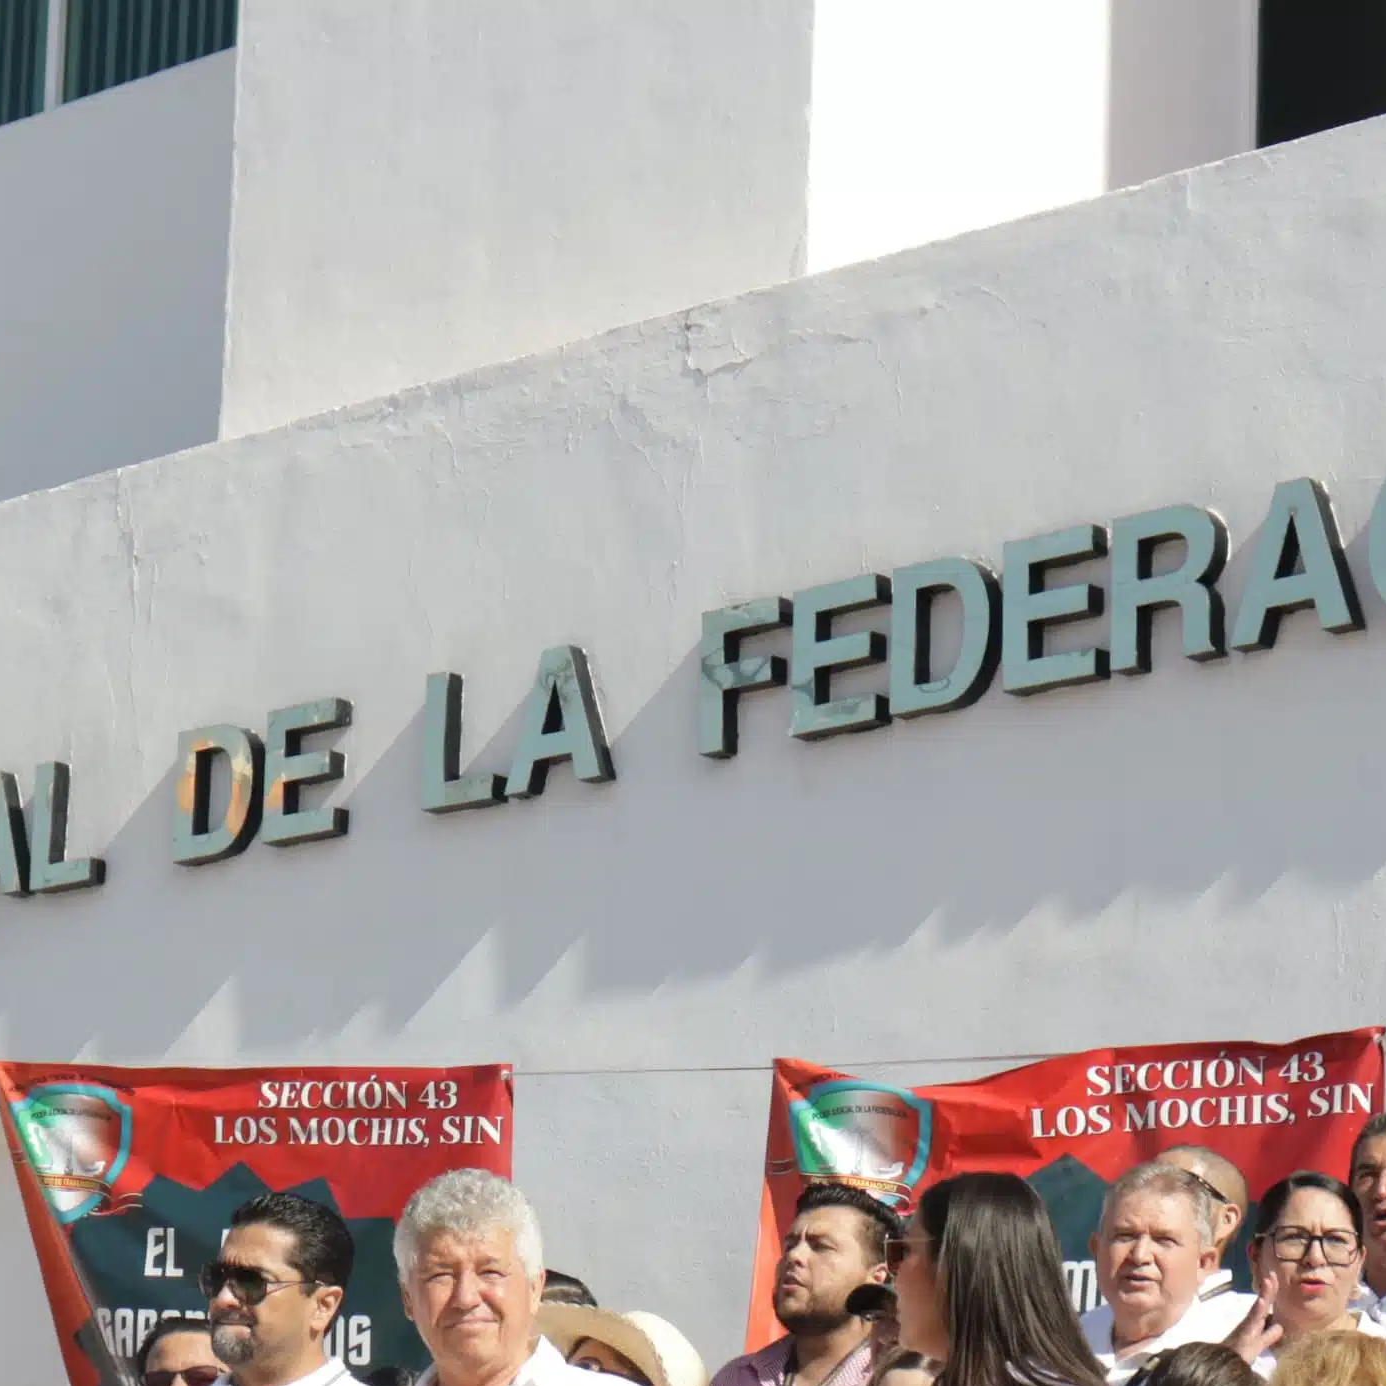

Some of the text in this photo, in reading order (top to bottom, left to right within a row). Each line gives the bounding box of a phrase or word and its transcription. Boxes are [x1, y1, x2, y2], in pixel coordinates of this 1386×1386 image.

[172, 697, 352, 868] DE
[421, 645, 615, 815] LA
[257, 1074, 458, 1110] SECCIÓN 43
[1086, 1051, 1326, 1097] SECCIÓN 43
[214, 1115, 505, 1148] LOS MOCHIS, SIN
[1031, 1082, 1374, 1140] LOS MOCHIS, SIN
[144, 1227, 184, 1277] EL
